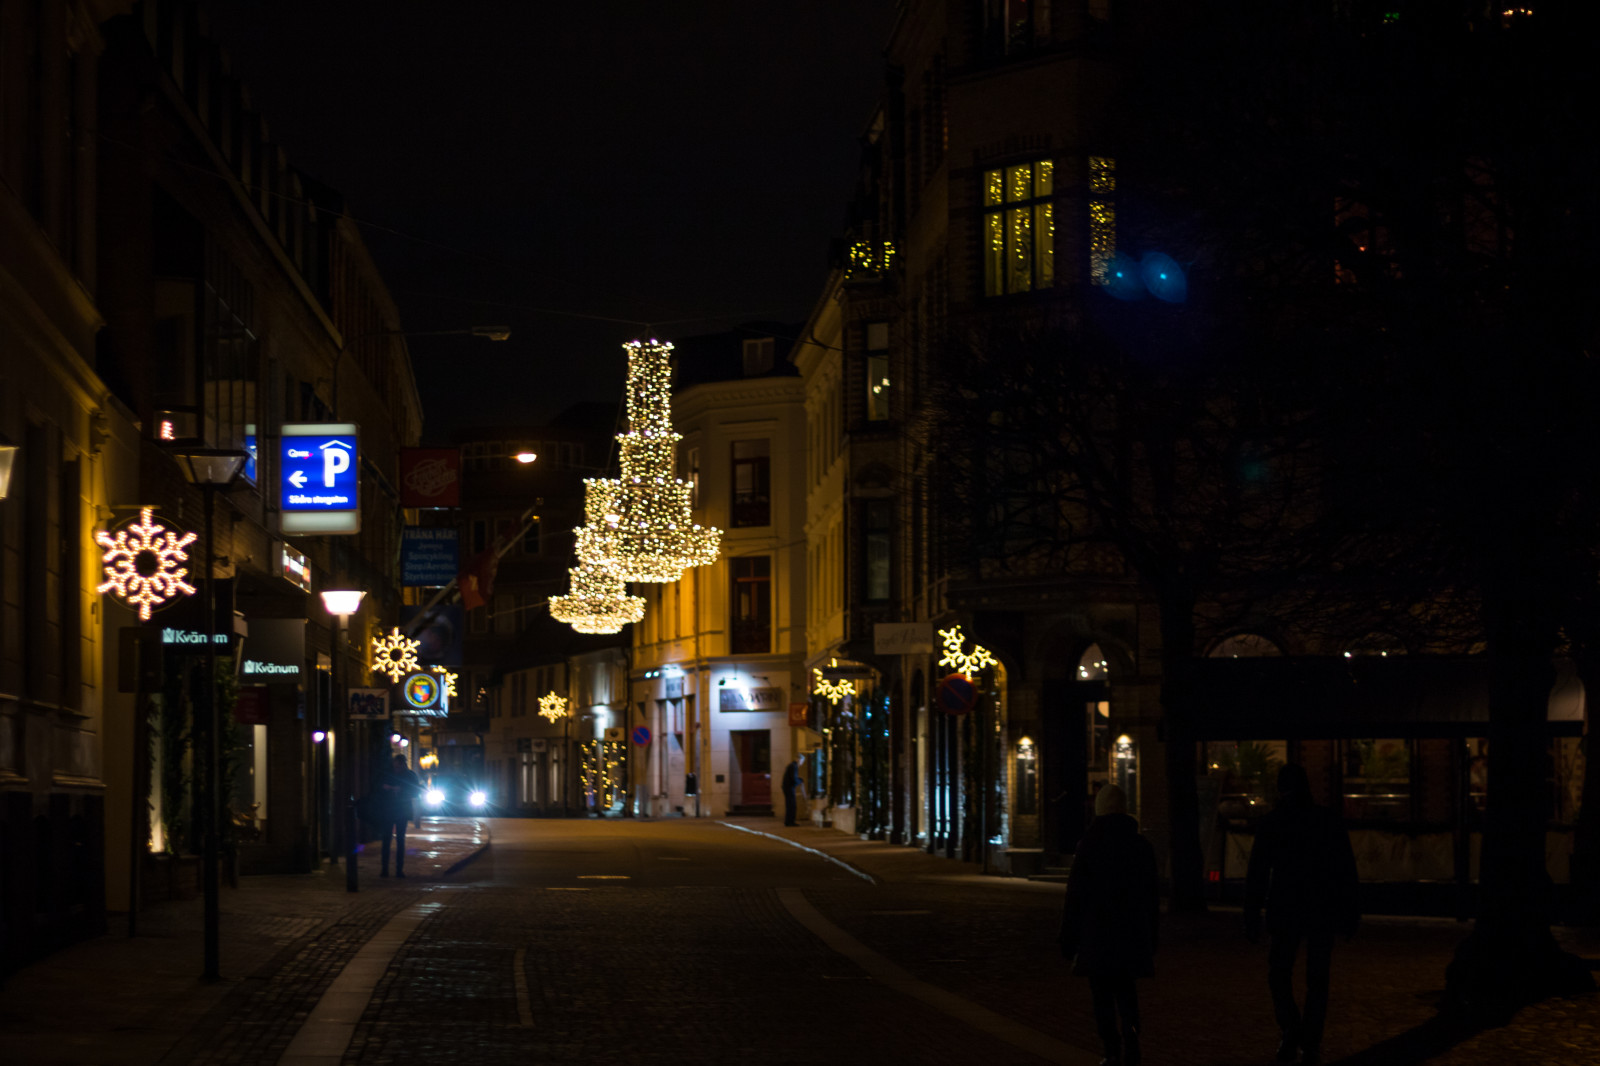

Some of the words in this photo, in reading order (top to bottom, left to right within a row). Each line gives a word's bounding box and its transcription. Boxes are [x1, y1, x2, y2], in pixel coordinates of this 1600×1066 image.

[324, 448, 350, 488] P
[175, 630, 228, 644] Kvänm
[255, 661, 299, 674] Kvänum
